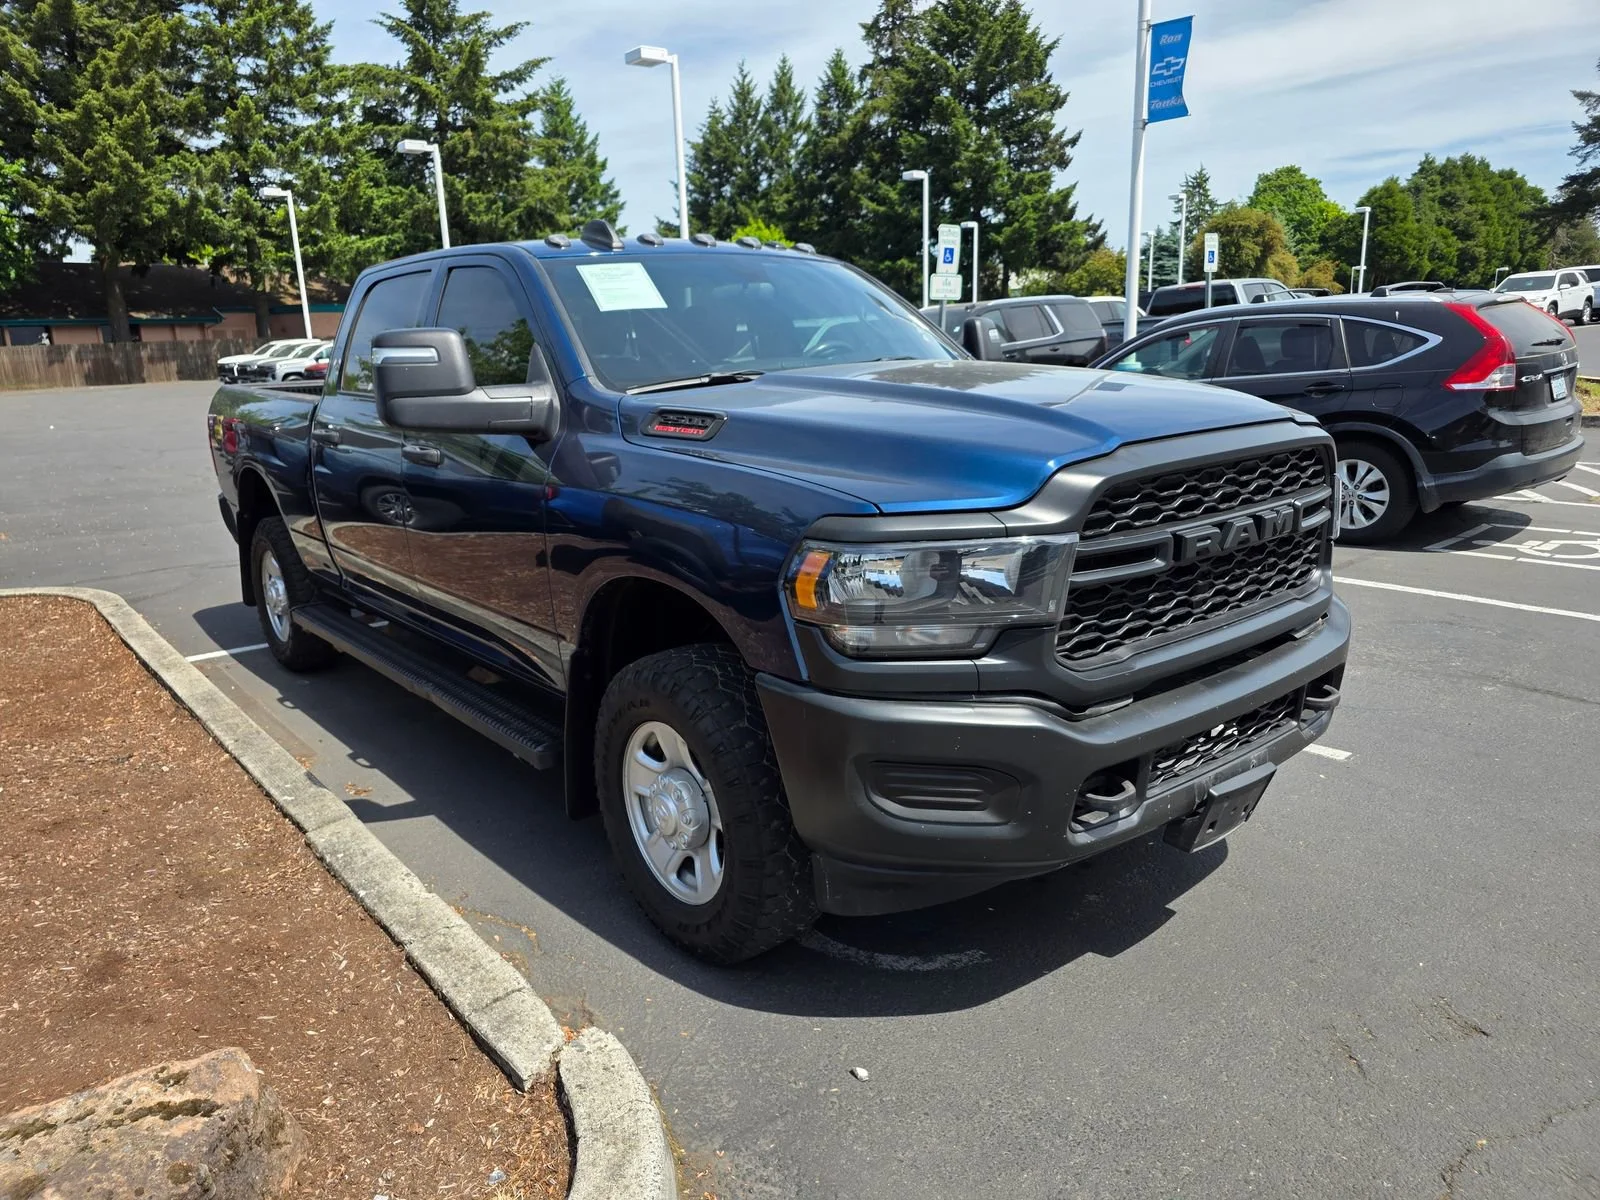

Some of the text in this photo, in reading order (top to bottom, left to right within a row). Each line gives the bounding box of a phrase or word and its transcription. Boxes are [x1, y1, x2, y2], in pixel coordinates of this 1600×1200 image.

[1159, 33, 1183, 45] Ron
[660, 414, 711, 426] 2500
[1176, 504, 1294, 561] RAM
